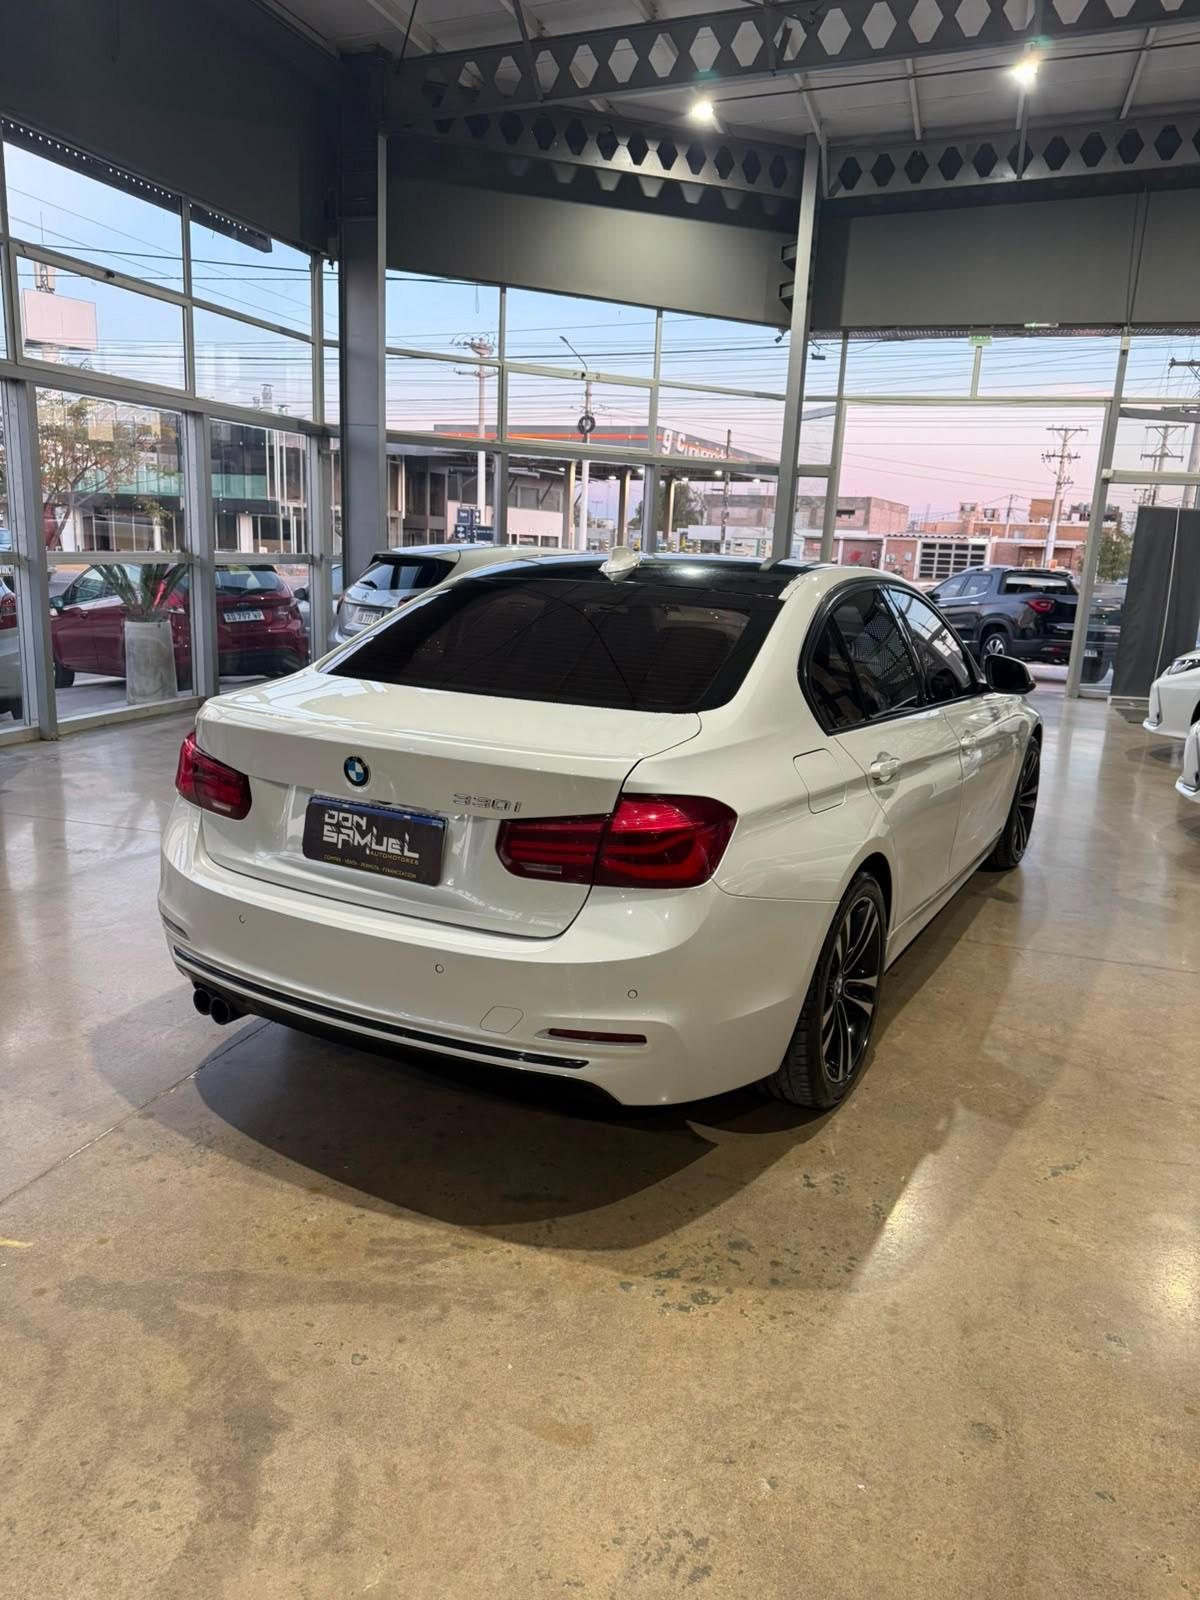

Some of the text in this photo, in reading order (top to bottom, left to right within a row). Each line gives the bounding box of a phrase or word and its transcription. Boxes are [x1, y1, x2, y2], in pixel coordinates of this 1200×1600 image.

[452, 792, 522, 813] 330i
[324, 809, 367, 830] DON
[322, 824, 420, 859] SAMUEL
[370, 850, 419, 866] AUTOMOTORES
